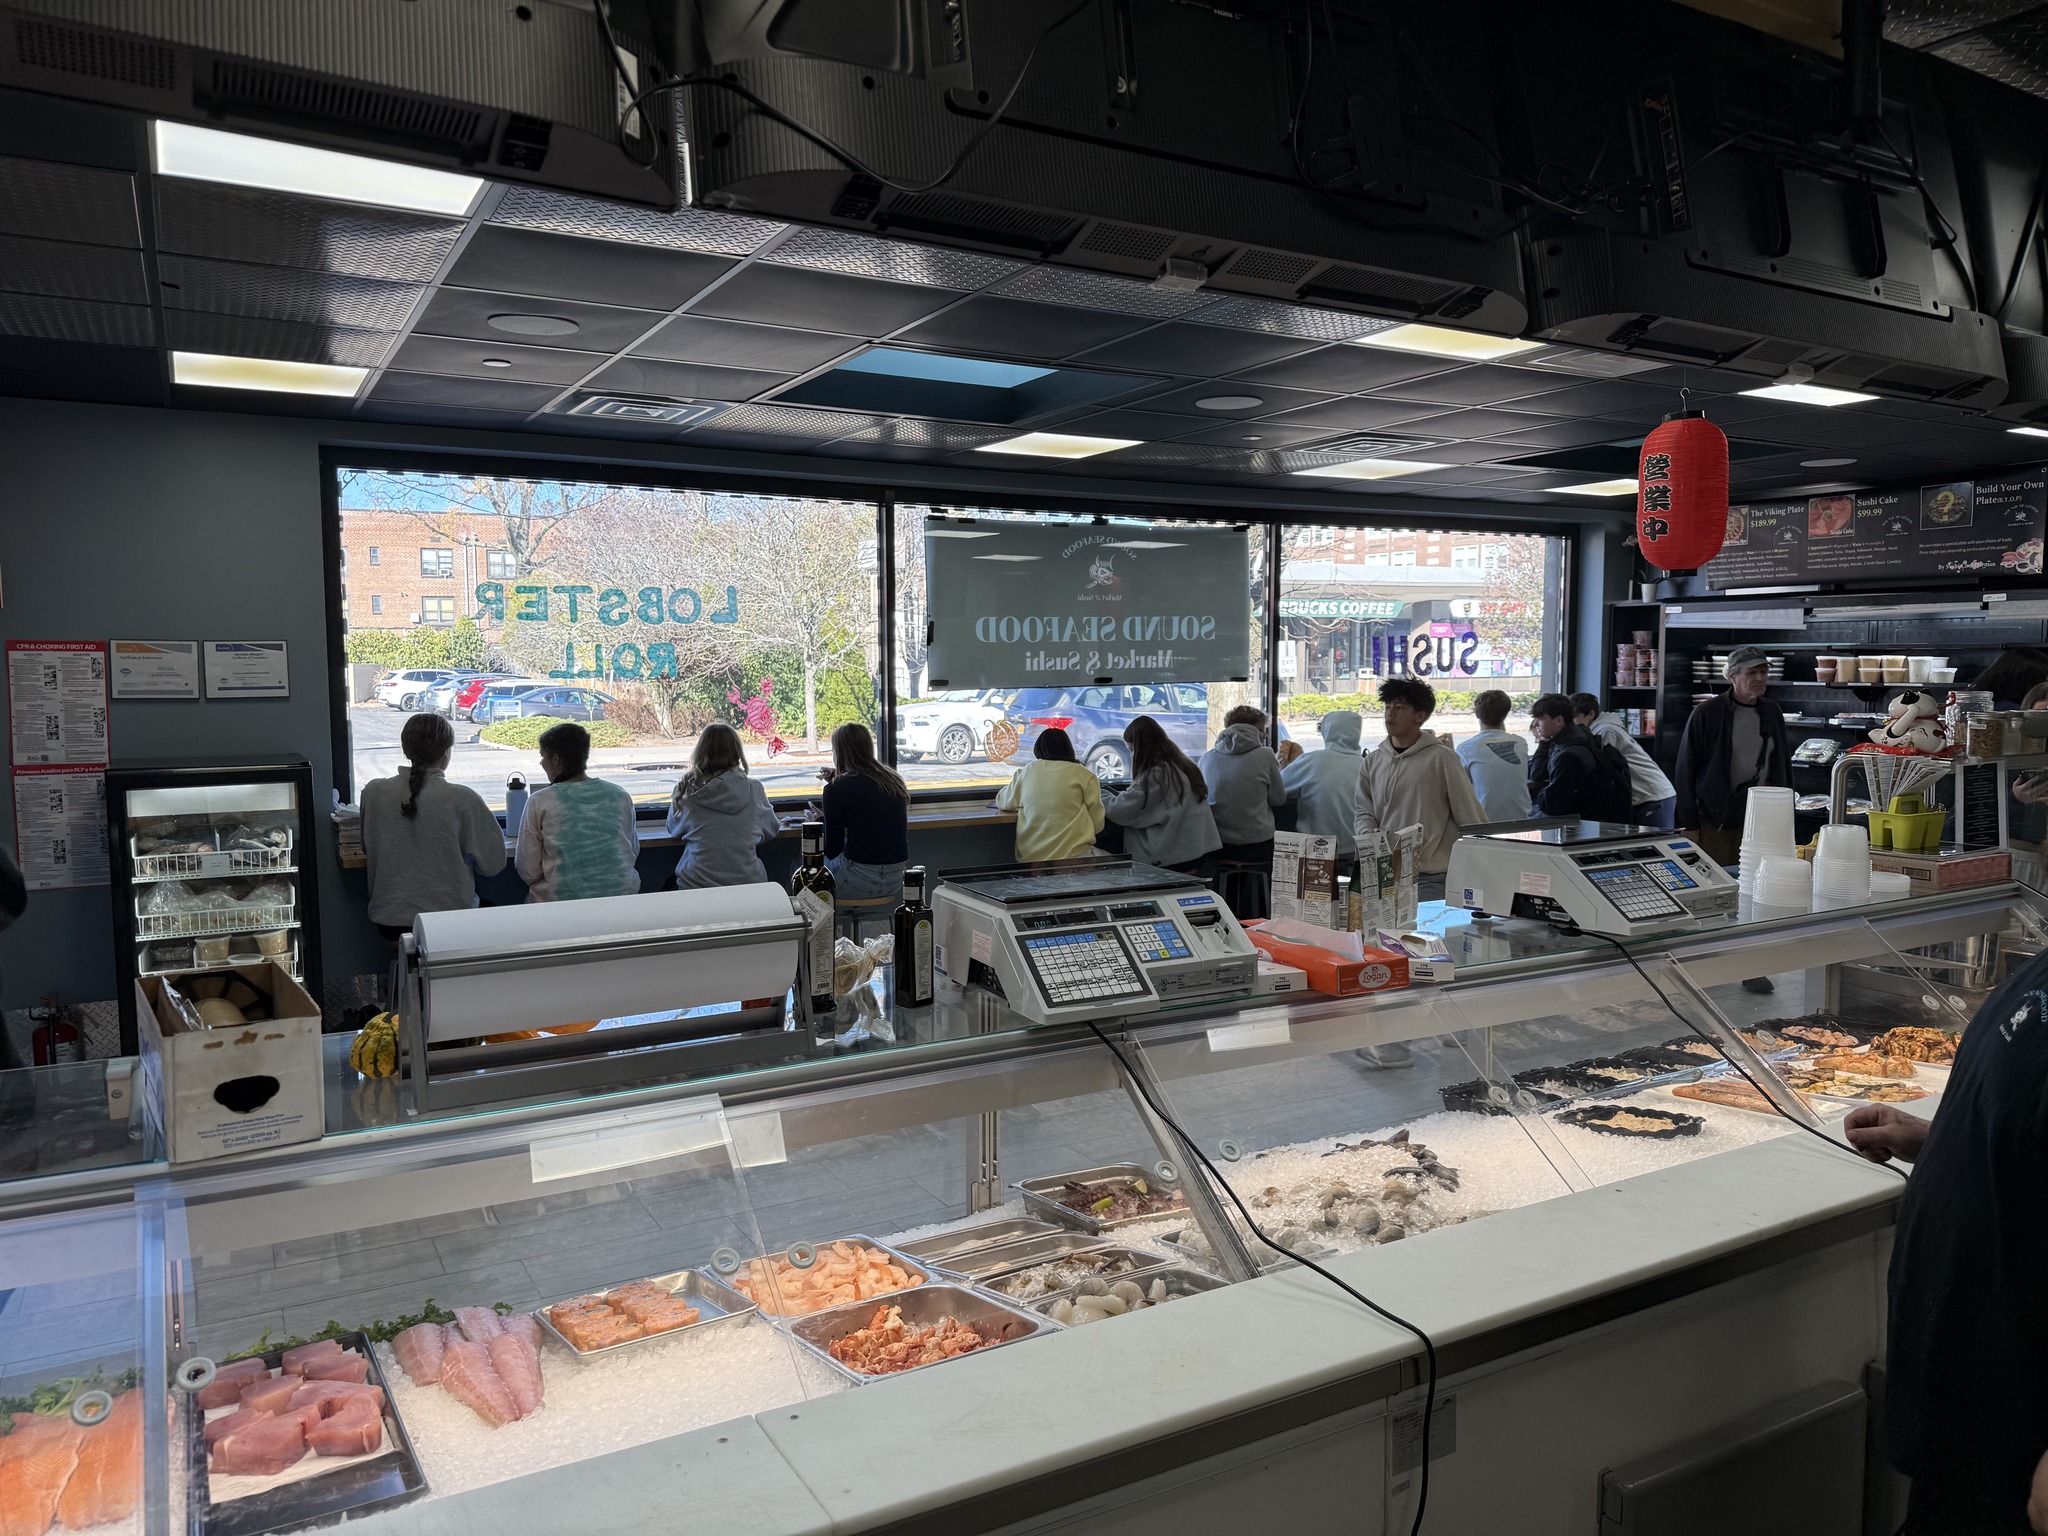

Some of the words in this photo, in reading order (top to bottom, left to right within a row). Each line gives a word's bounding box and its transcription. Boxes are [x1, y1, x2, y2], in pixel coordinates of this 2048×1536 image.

[1976, 484, 1998, 494] Build
[2000, 484, 2022, 492] Your
[2023, 481, 2044, 490] Own
[1857, 497, 1878, 507] Sushi
[1879, 495, 1899, 505] Cake
[1976, 496, 1998, 505] Plate
[1750, 509, 1763, 517] The
[1764, 507, 1786, 517] Viking
[1787, 506, 1805, 514] Plate
[1857, 508, 1882, 518] $99.99
[1750, 518, 1777, 528] $189.99
[1340, 601, 1395, 616] COFFEE
[1363, 971, 1388, 983] Logan
